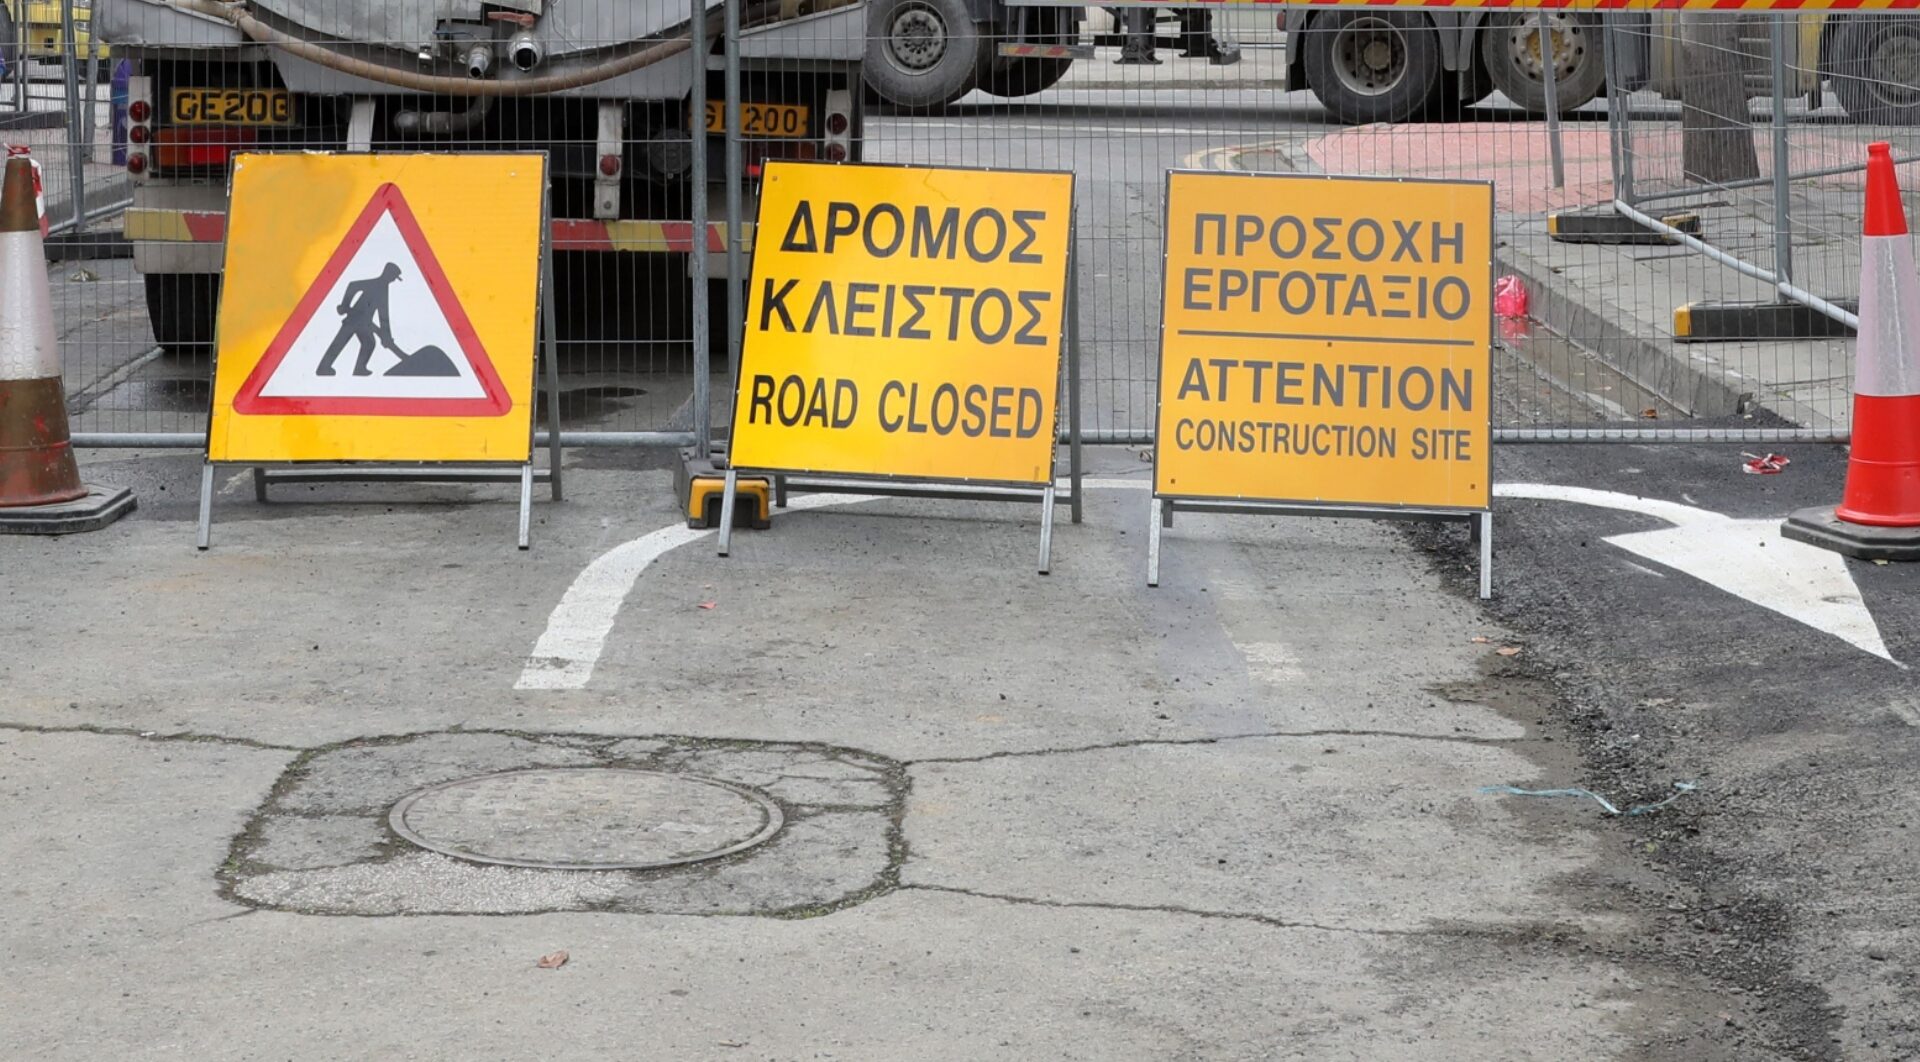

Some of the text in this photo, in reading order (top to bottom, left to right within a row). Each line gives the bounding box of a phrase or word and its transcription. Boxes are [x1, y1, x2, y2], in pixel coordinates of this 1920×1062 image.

[744, 106, 798, 133] 200
[780, 200, 1046, 264] ΔΡΟΜΟΣ
[1193, 212, 1464, 264] ΠΡΟΣΟΧΗ
[760, 278, 1051, 346] ΚΛΕΙΣΤΟΣ
[1183, 267, 1471, 321] ΕΡΓΟΤΑΞΙΟ
[749, 375, 1043, 439] ROAD CLOSED
[1177, 357, 1473, 412] ATTENTION
[1176, 418, 1471, 461] CONSTRUCTION SITE
